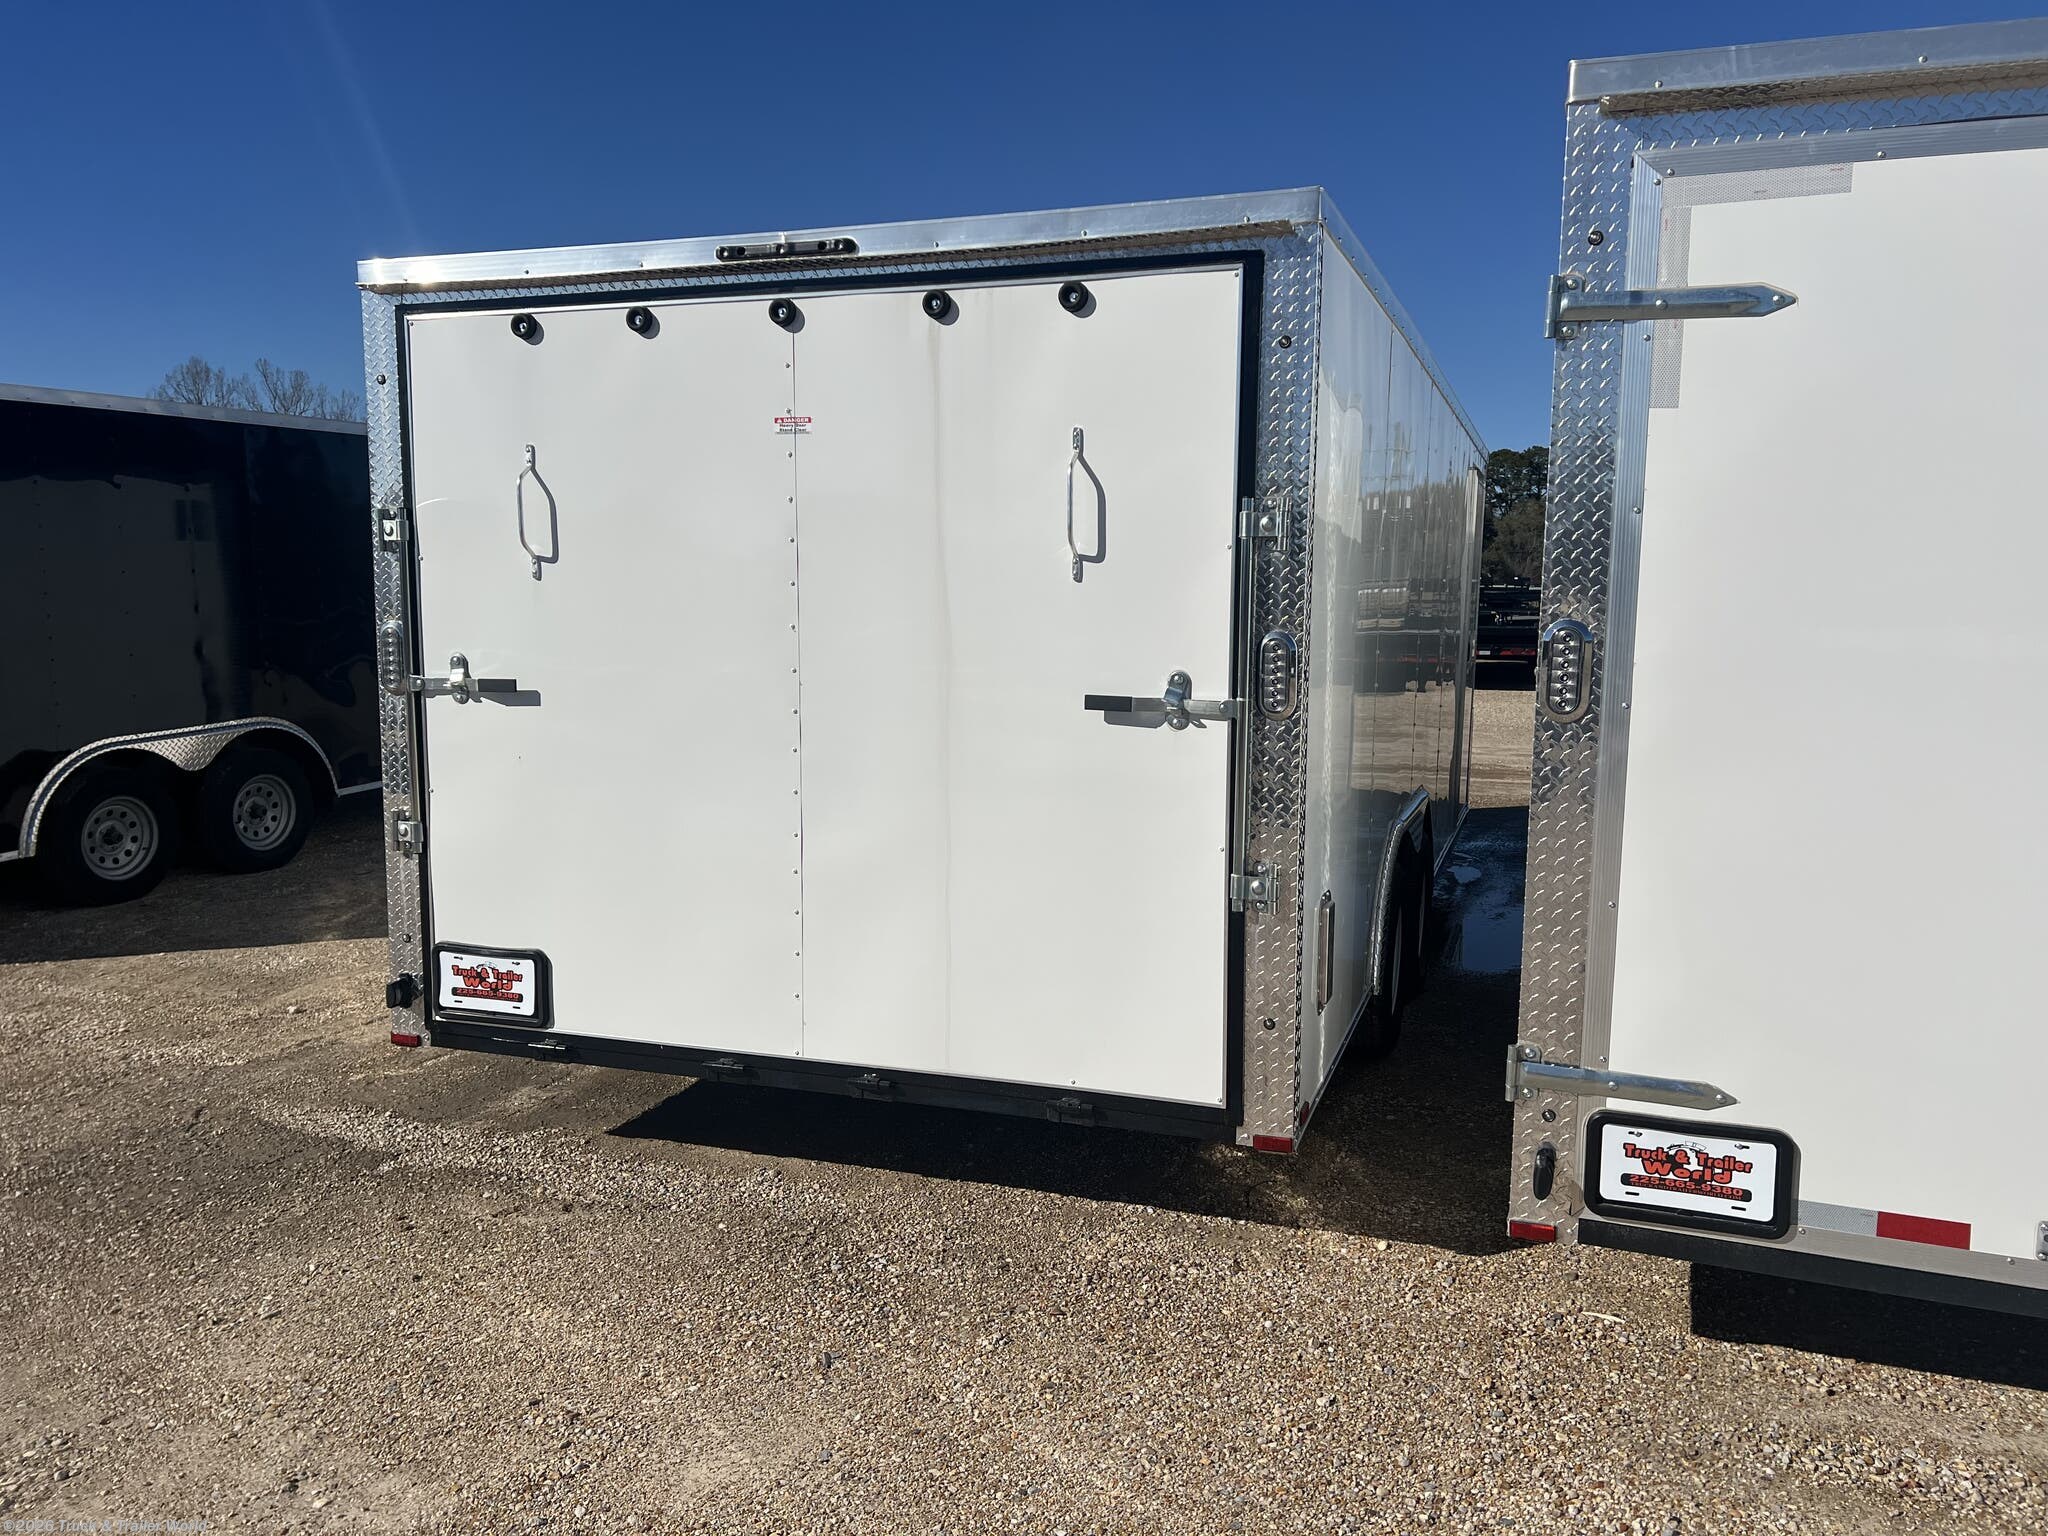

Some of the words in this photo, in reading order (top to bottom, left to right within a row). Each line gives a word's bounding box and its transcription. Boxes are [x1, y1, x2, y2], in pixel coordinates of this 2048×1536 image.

[452, 965, 478, 977] Truck
[481, 968, 489, 978] &
[492, 968, 523, 982] Trailer
[463, 976, 514, 991] World
[1623, 1142, 1668, 1161] Truck
[1674, 1149, 1691, 1164] &
[1695, 1152, 1753, 1173] Trailer
[1641, 1159, 1733, 1184] World
[1629, 1174, 1744, 1196] 225-665-9380
